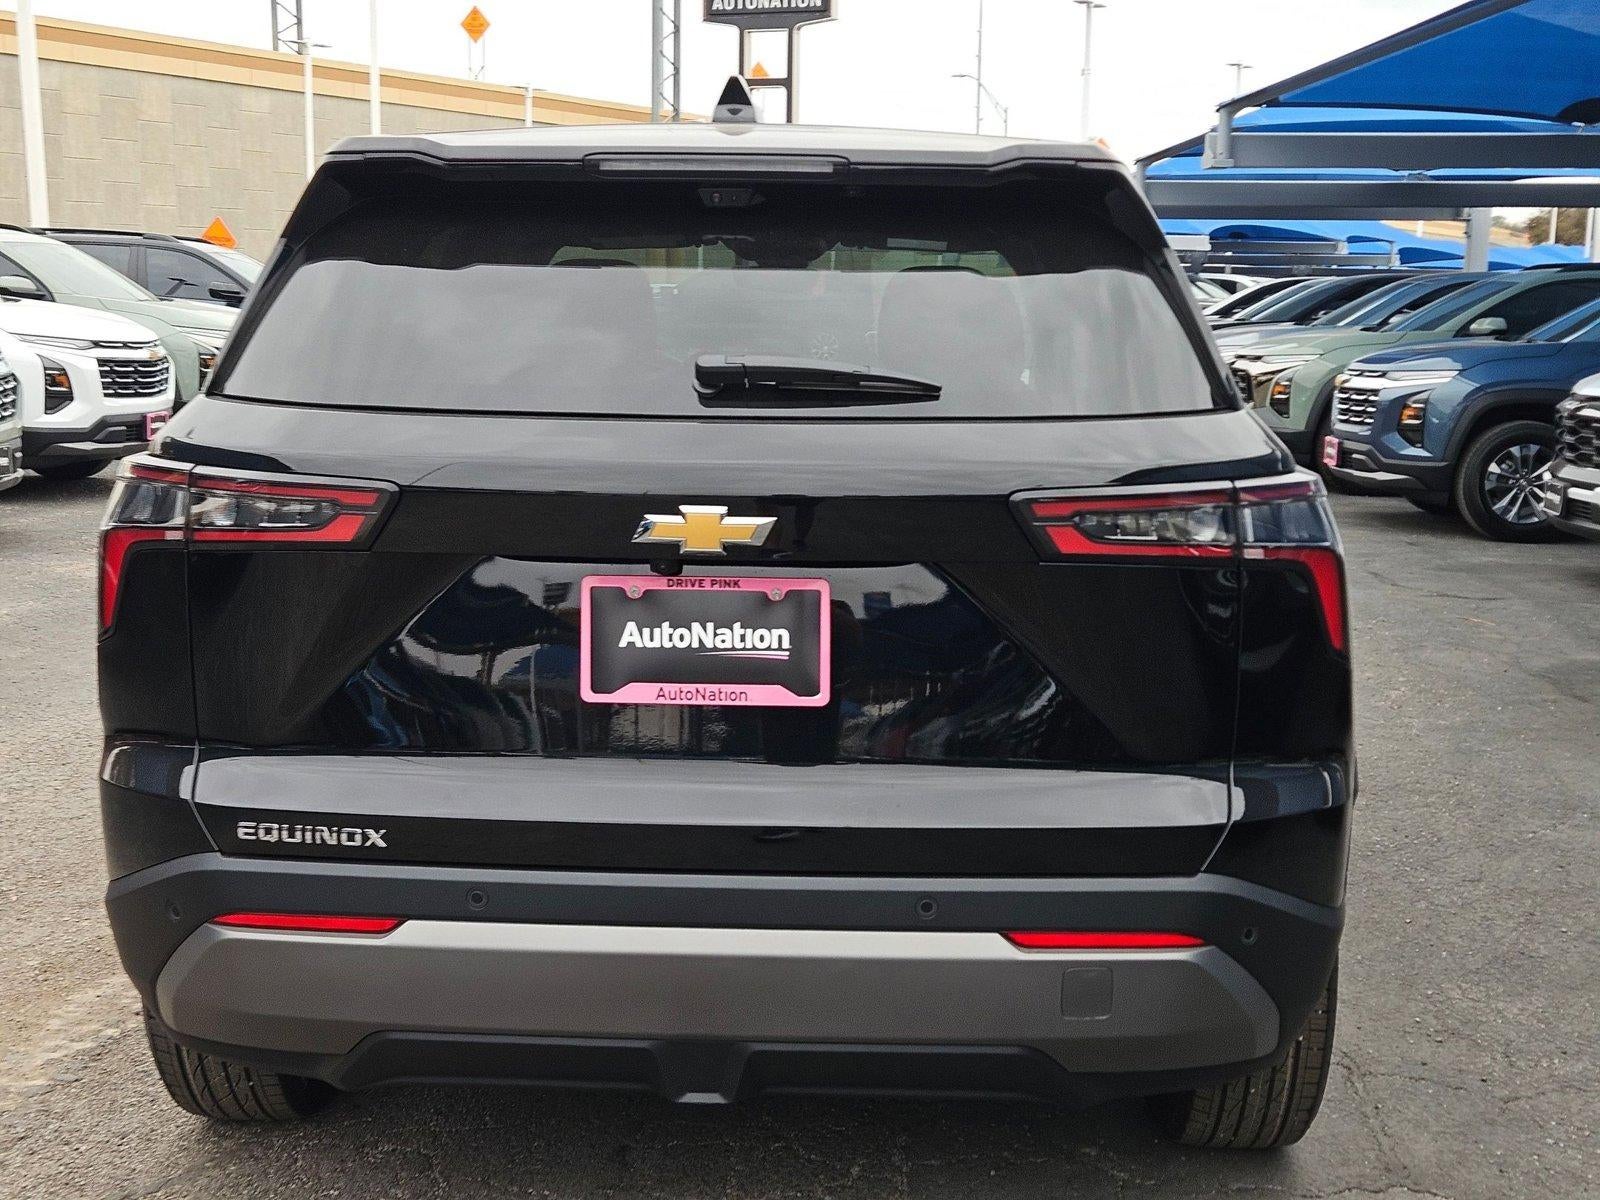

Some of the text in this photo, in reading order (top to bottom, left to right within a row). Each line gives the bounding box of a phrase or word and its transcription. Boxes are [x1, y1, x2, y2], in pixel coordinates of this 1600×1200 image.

[667, 578, 741, 589] DRIVE PINK
[618, 620, 790, 649] AutoNation
[656, 686, 748, 702] AutoNation
[236, 821, 388, 848] EQUINOX
